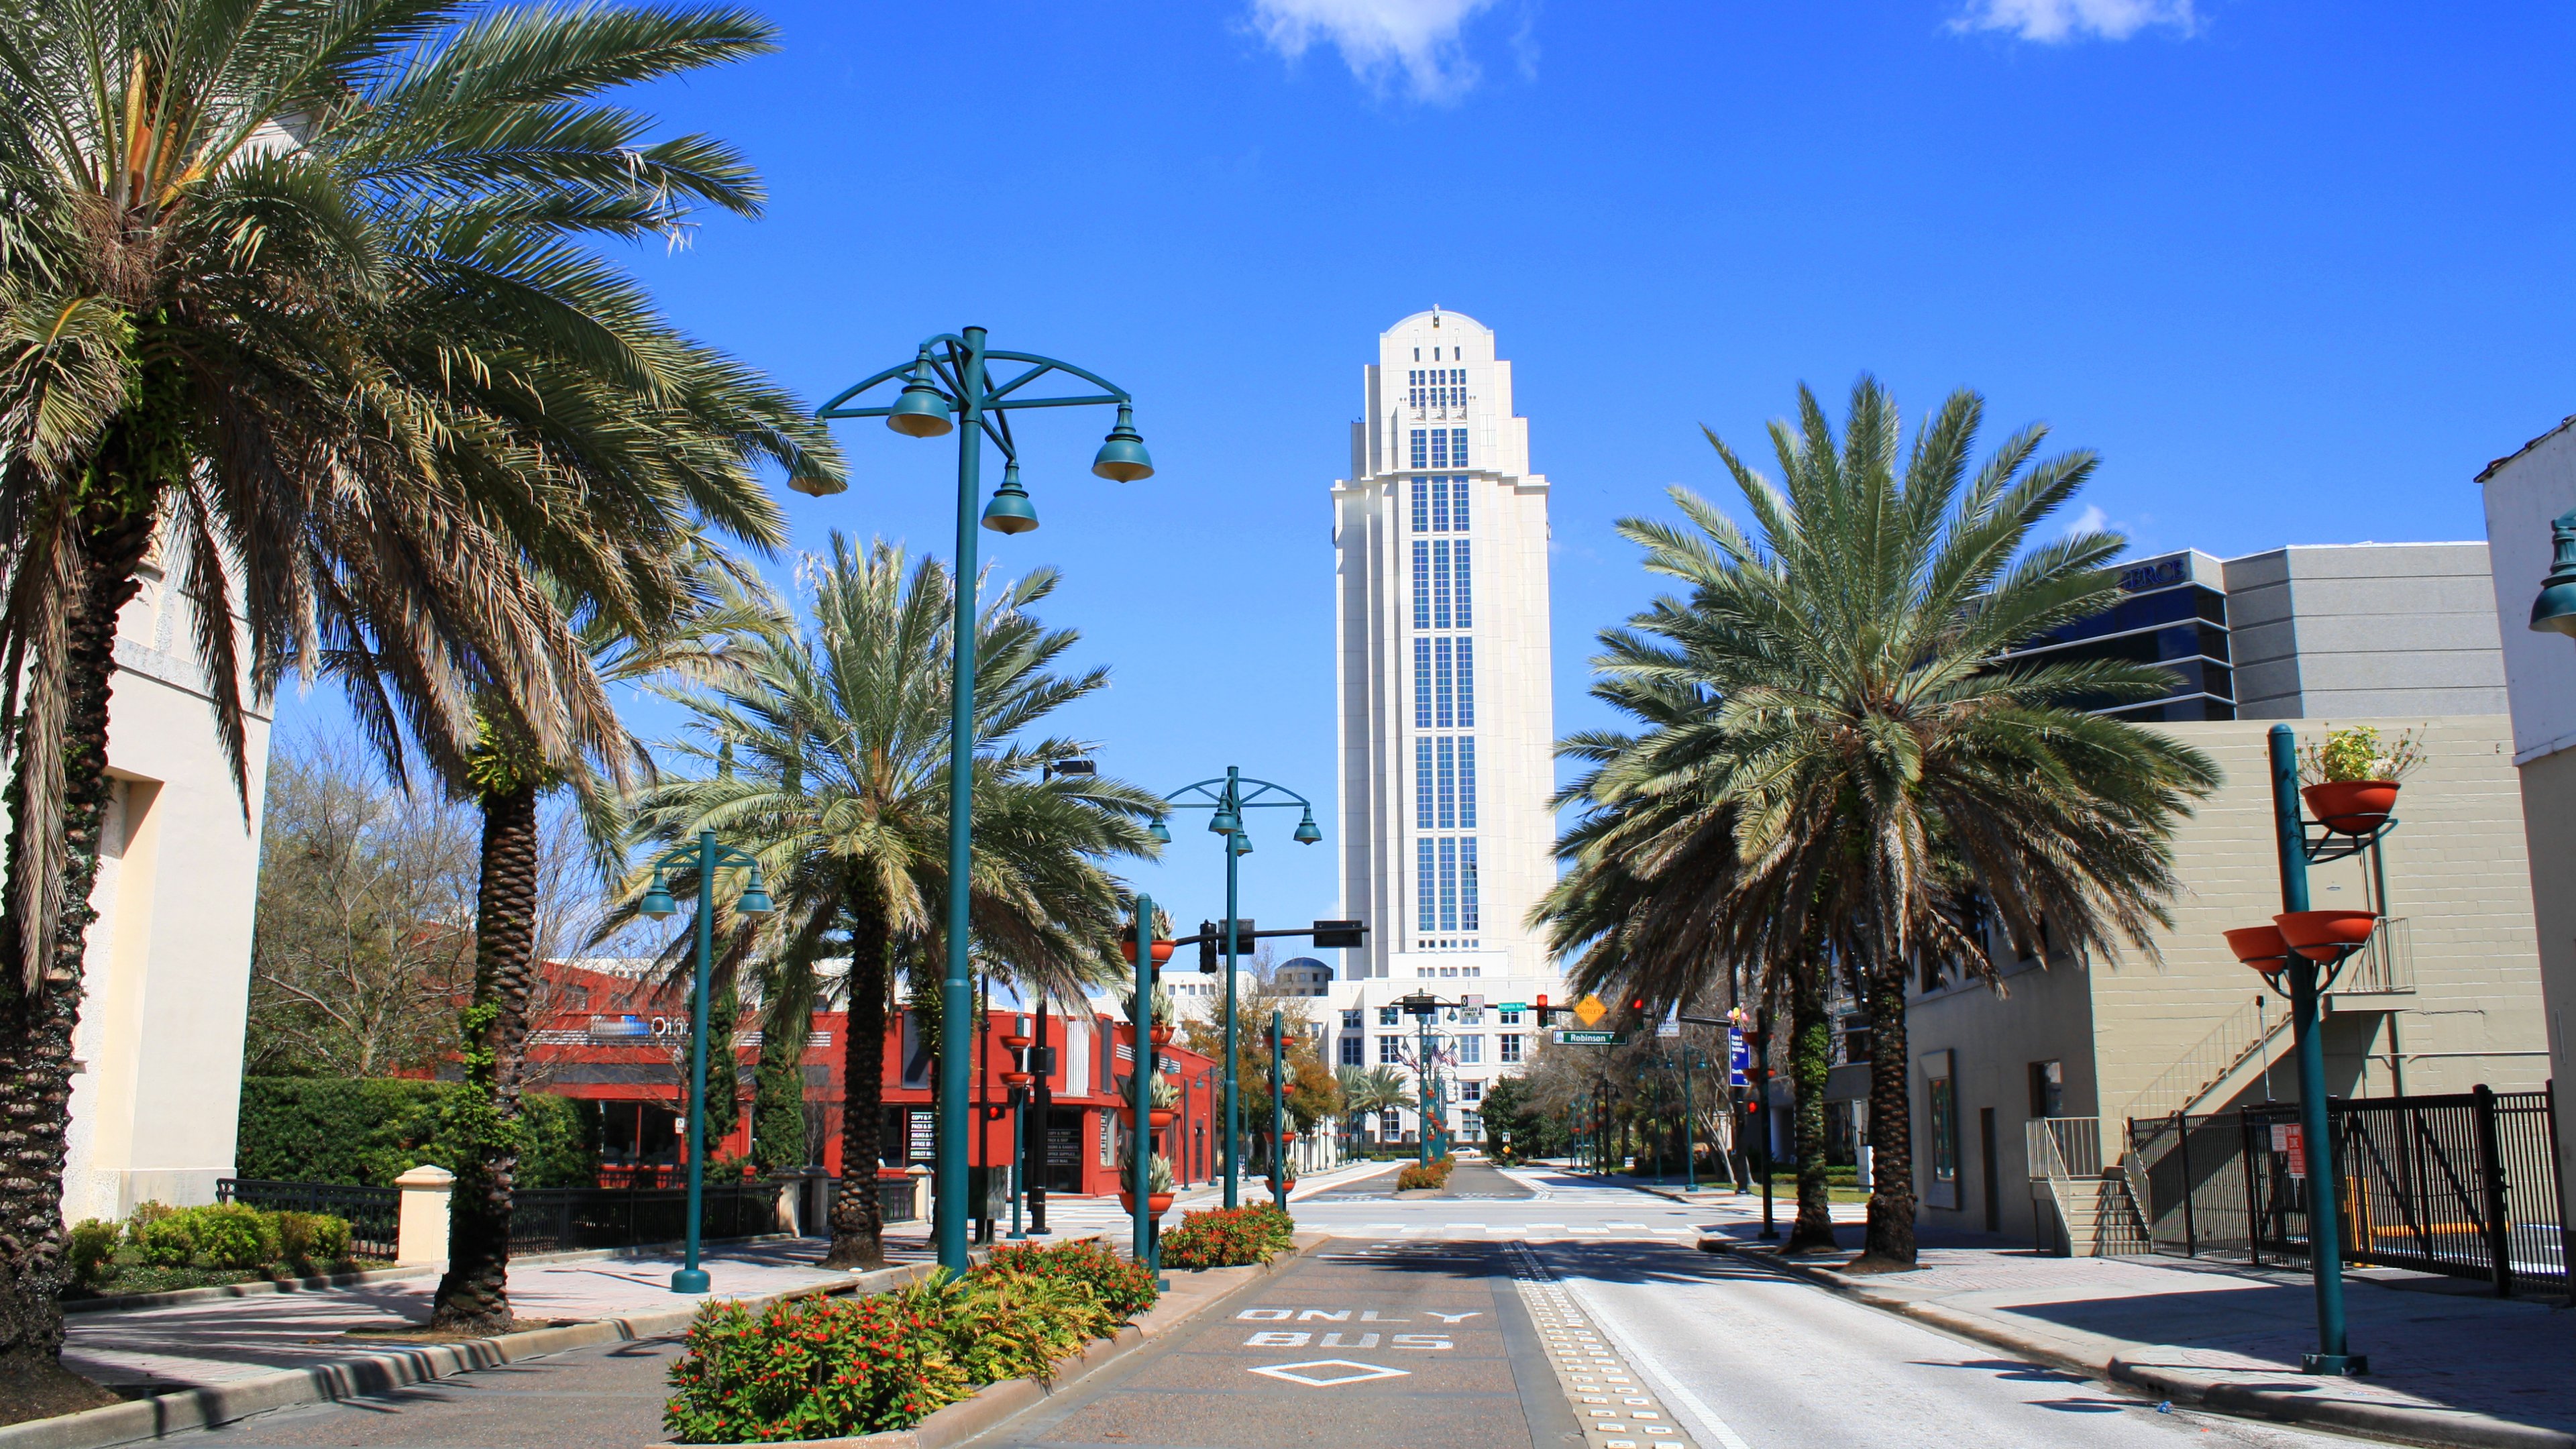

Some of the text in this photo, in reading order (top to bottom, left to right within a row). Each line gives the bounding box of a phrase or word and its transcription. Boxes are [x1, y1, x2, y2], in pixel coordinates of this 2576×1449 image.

[1570, 1034, 1606, 1042] Robinson
[1236, 1309, 1483, 1323] ONLY
[1243, 1332, 1454, 1349] BUS
